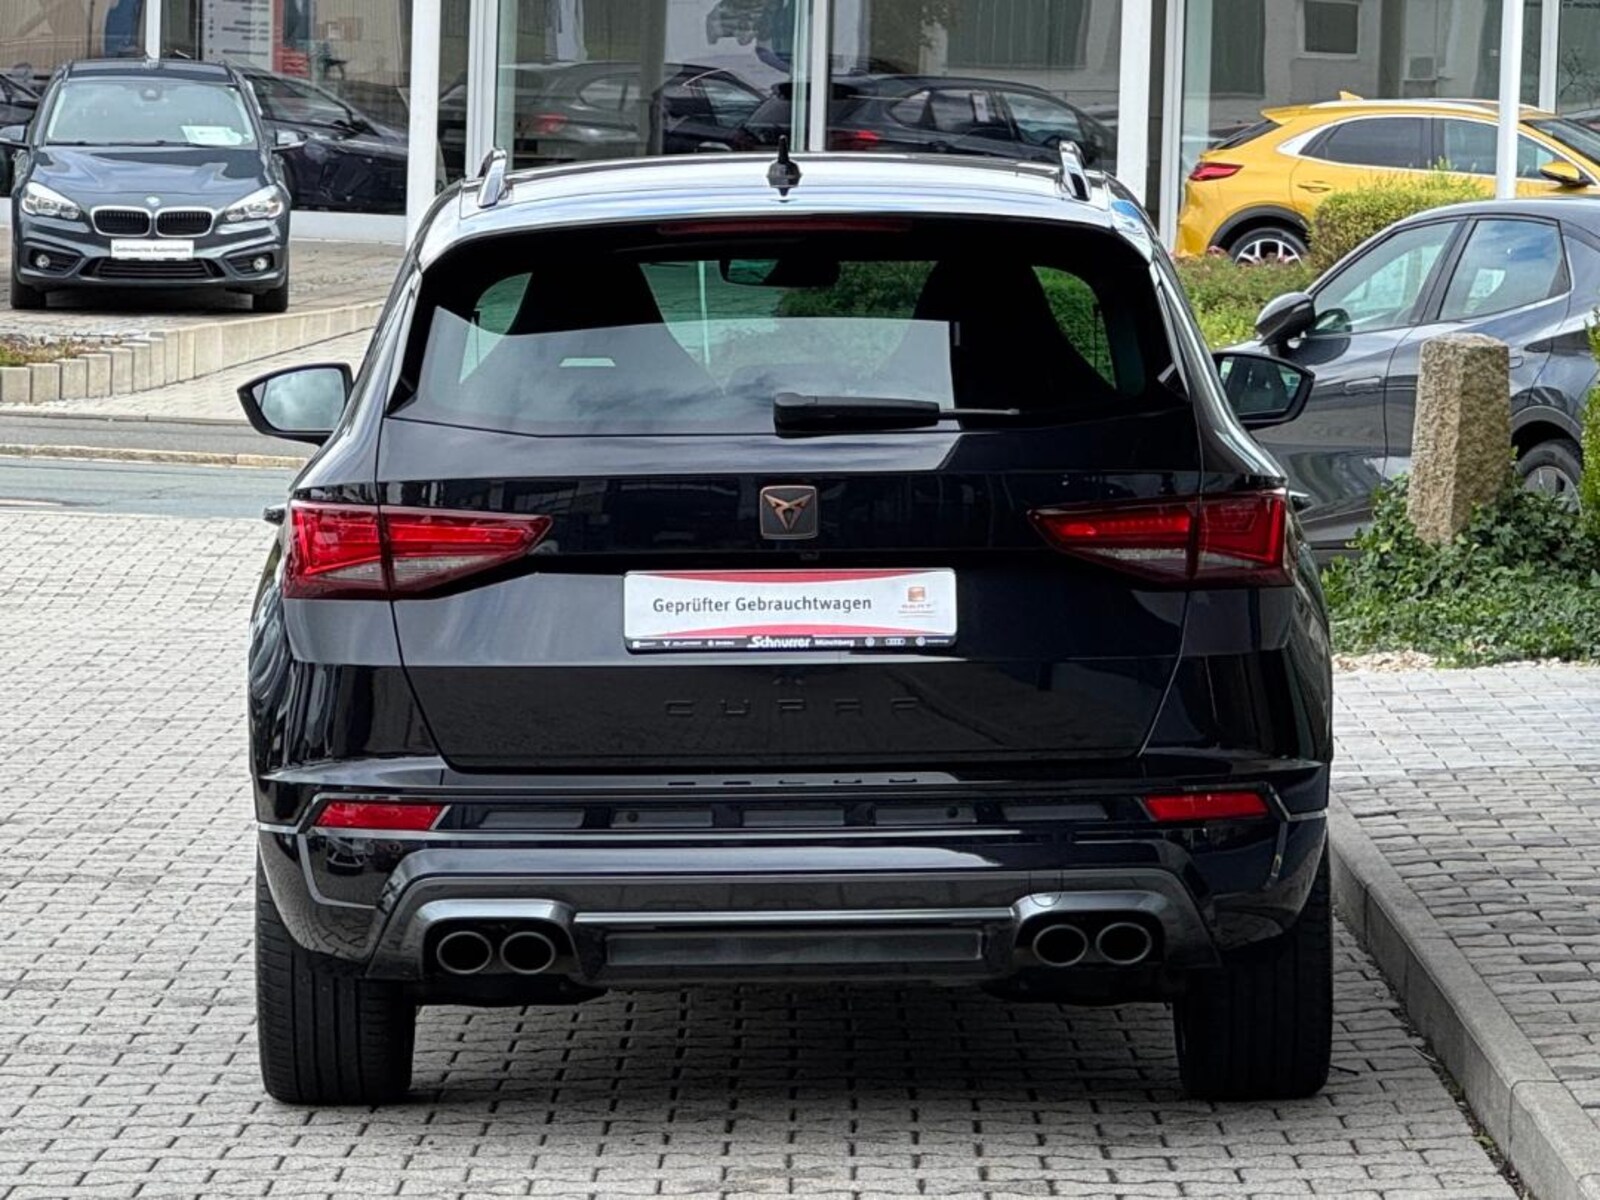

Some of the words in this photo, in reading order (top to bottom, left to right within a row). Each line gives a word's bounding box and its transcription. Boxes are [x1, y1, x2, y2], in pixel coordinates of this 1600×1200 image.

[653, 598, 730, 616] Geprüfter
[735, 596, 873, 614] Gebrauchtwagen
[747, 635, 812, 648] Schnurrer
